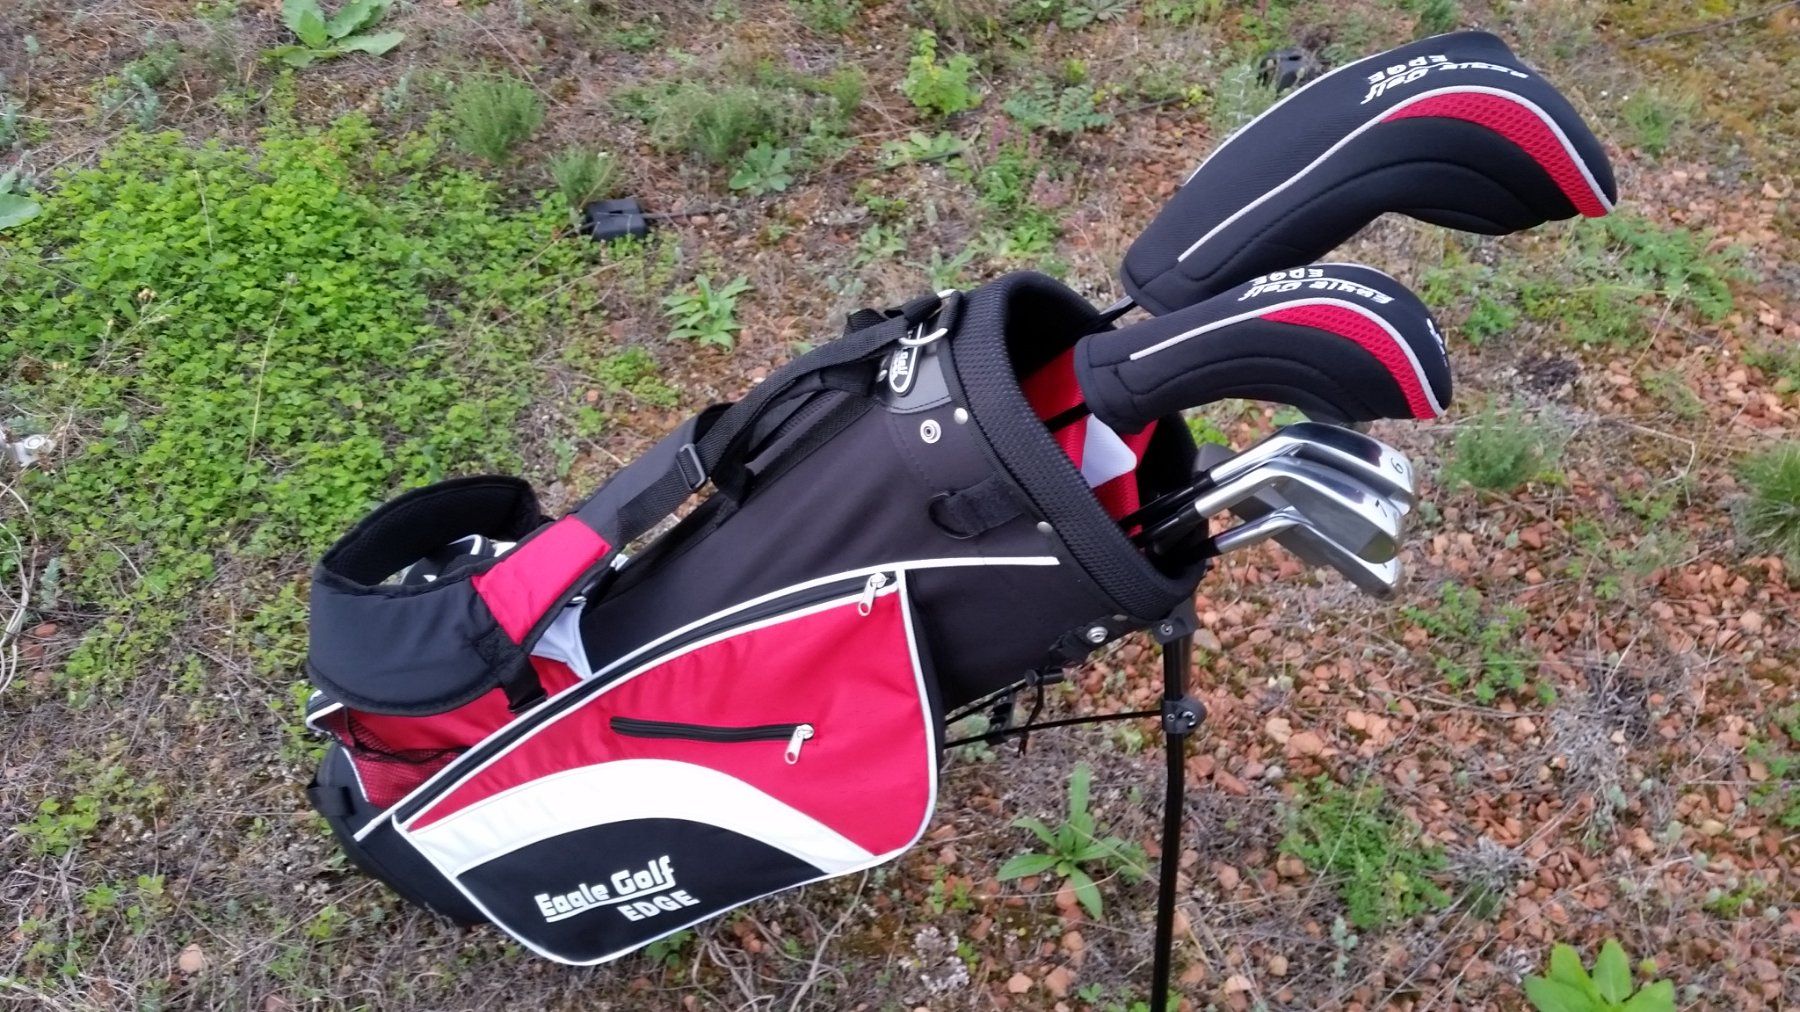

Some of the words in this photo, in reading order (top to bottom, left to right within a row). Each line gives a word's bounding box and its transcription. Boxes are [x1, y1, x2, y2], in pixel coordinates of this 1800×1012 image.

[1366, 54, 1449, 86] EDGE
[1360, 68, 1430, 105] Golf
[1237, 280, 1303, 302] Golf
[1249, 267, 1324, 287] EDGE
[1308, 279, 1395, 304] Eagle
[534, 883, 610, 920] Eagle
[610, 855, 677, 897] Golf
[616, 889, 701, 922] EDGE
